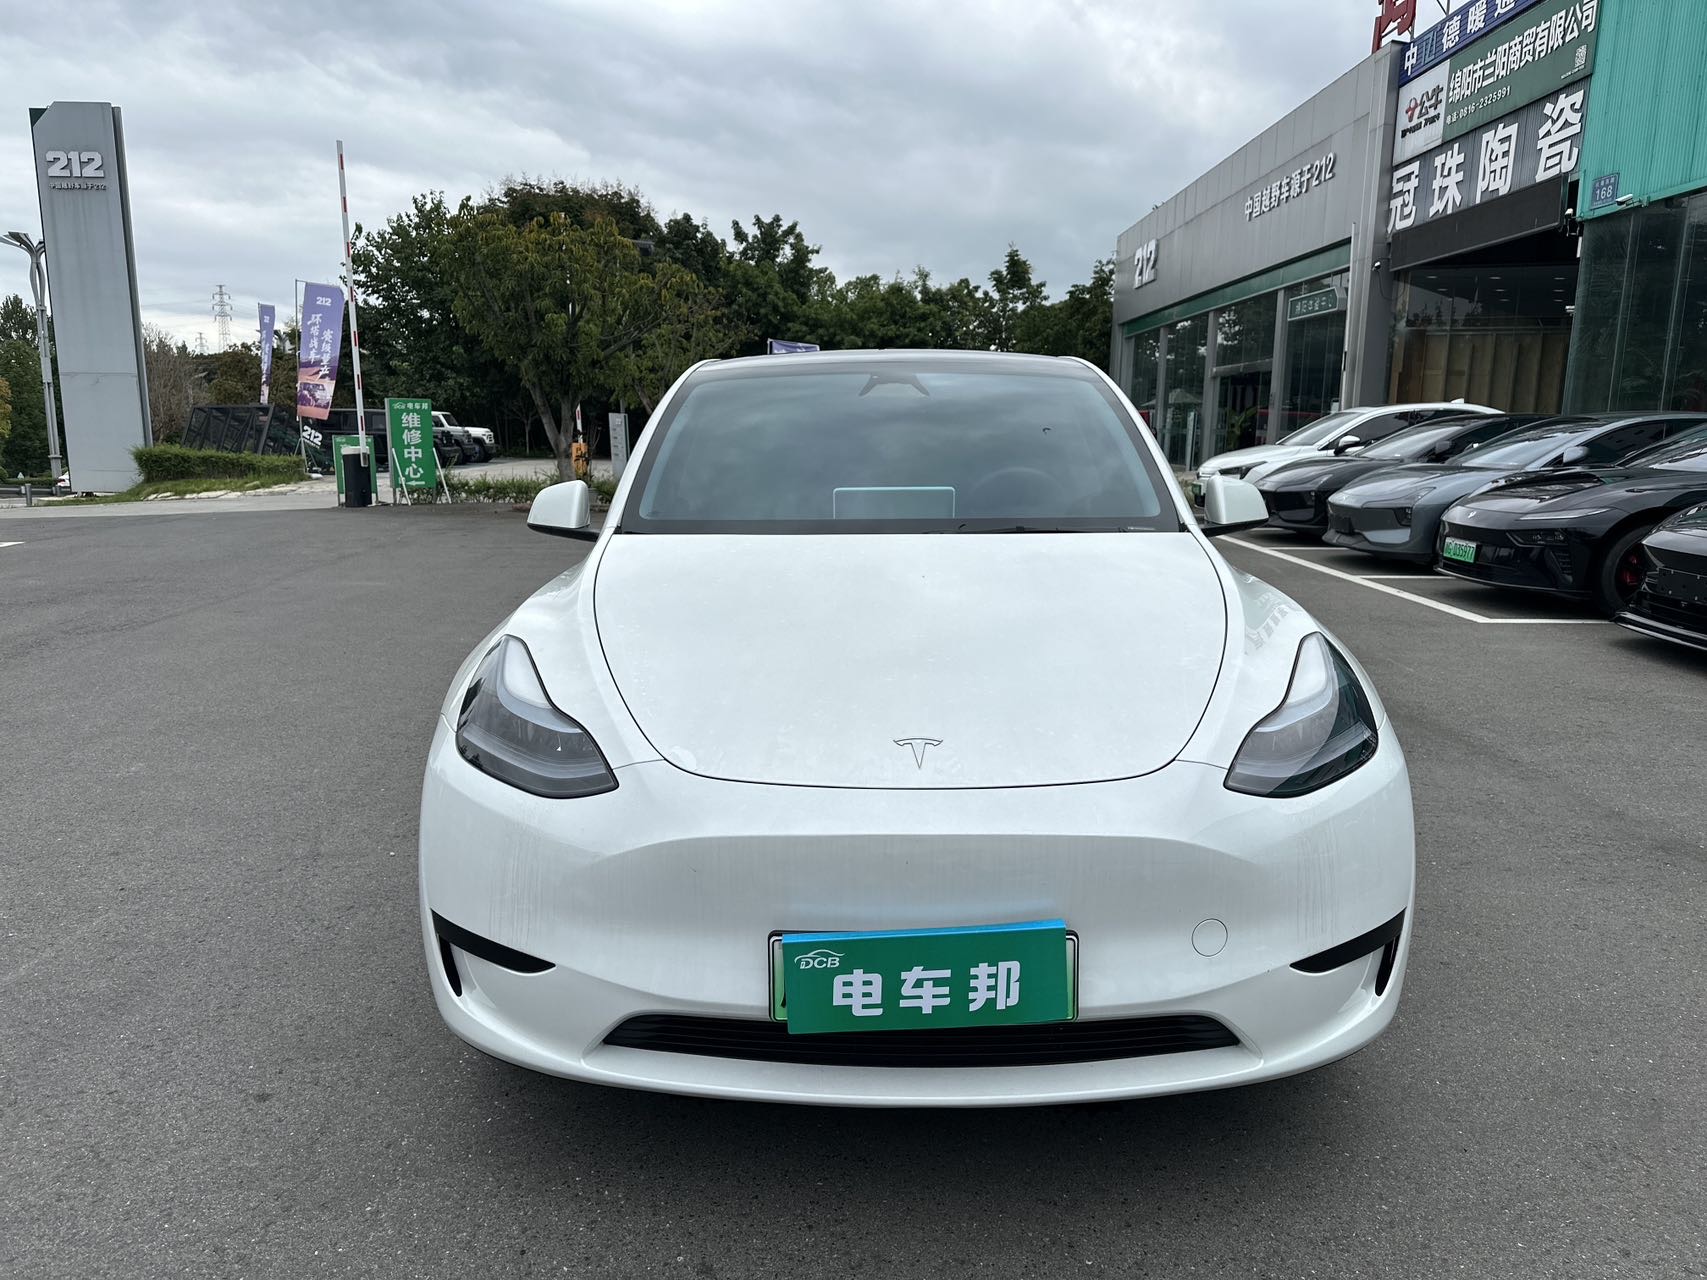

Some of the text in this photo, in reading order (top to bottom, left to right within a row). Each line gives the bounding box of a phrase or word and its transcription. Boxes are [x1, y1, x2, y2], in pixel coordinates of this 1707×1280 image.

[1448, 0, 1598, 104] 绵阳市兰阳商贸有限公司
[45, 150, 105, 178] 212
[1387, 89, 1585, 234] 冠珠陶瓷
[1244, 152, 1336, 221] 中国越野车源于212
[1596, 185, 1612, 201] 168
[1134, 239, 1157, 288] 212
[316, 296, 332, 306] 212
[407, 402, 429, 410] 电车邦
[302, 425, 323, 446] 212
[401, 412, 424, 478] 维修中心
[800, 956, 840, 970] DCB
[832, 960, 1021, 1018] 电车邦
